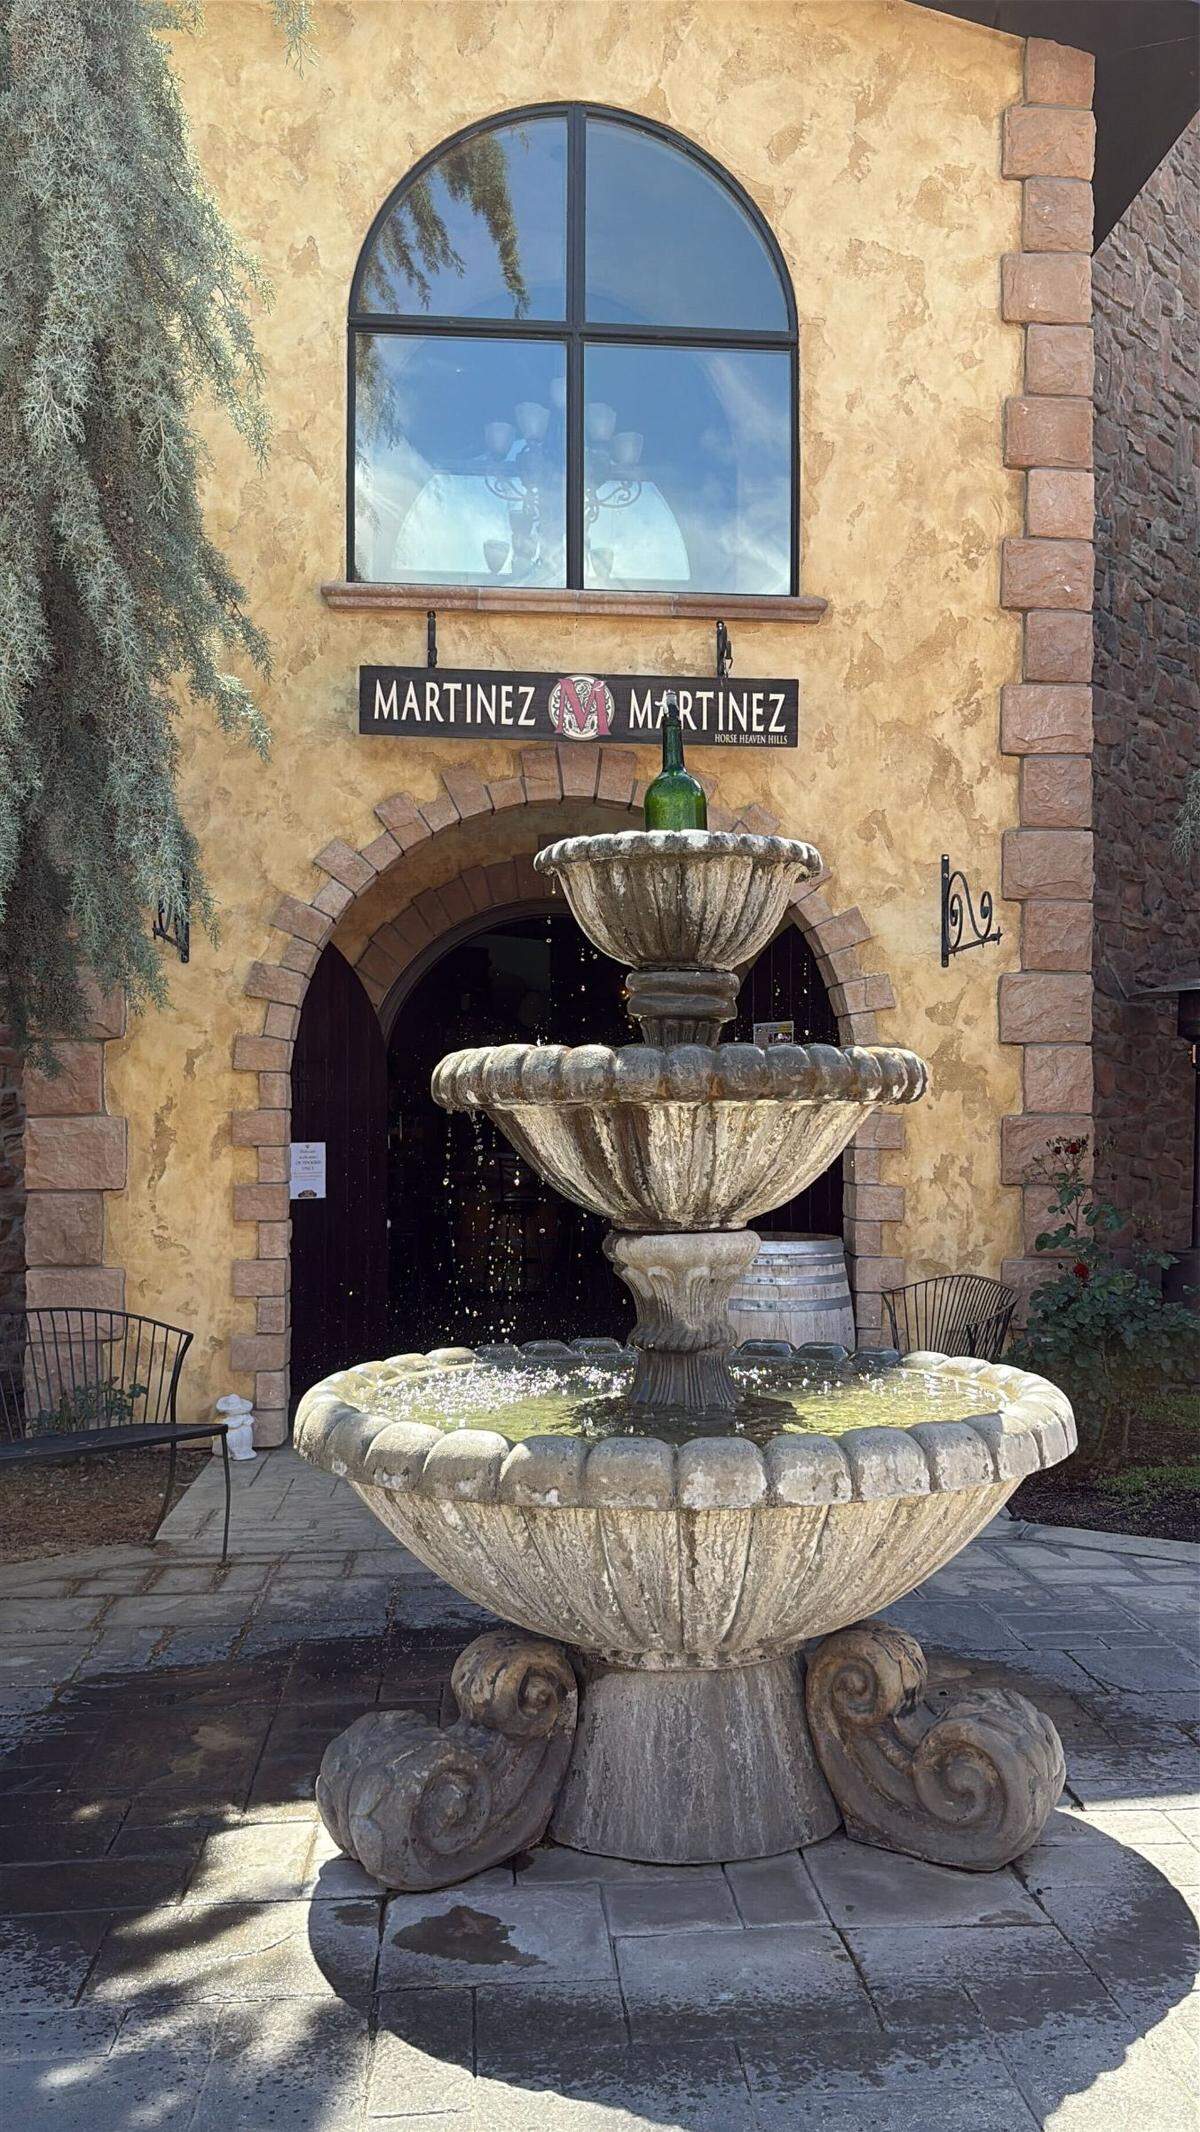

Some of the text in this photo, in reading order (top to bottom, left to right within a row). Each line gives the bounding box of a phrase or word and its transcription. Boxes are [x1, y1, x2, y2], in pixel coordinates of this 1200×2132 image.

[374, 679, 536, 726] MARTINEZ
[714, 733, 788, 745] HORSE HEAVEN HILLS
